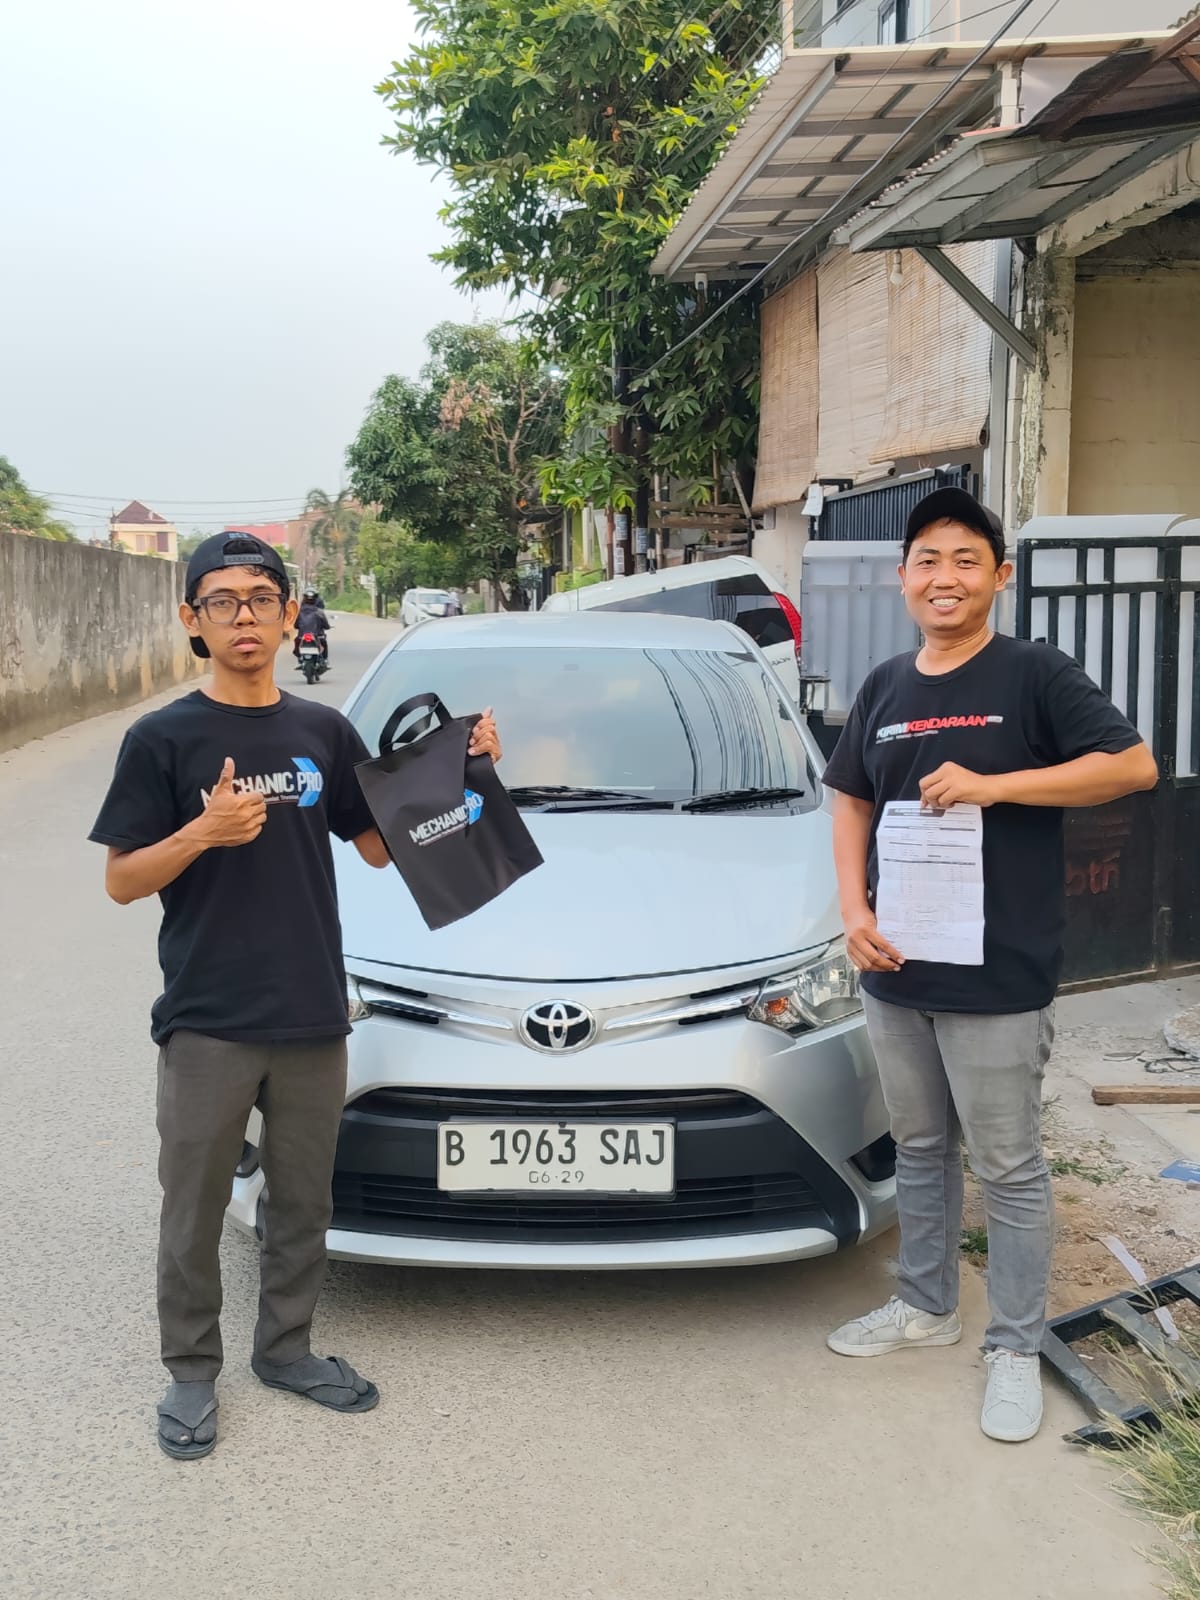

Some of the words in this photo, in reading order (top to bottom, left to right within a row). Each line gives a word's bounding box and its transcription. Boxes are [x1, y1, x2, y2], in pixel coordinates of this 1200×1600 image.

[296, 771, 322, 792] PRO
[408, 804, 468, 843] MECHANIC
[445, 1130, 465, 1166] B
[489, 1128, 576, 1165] 1963
[599, 1128, 665, 1165] SAJ
